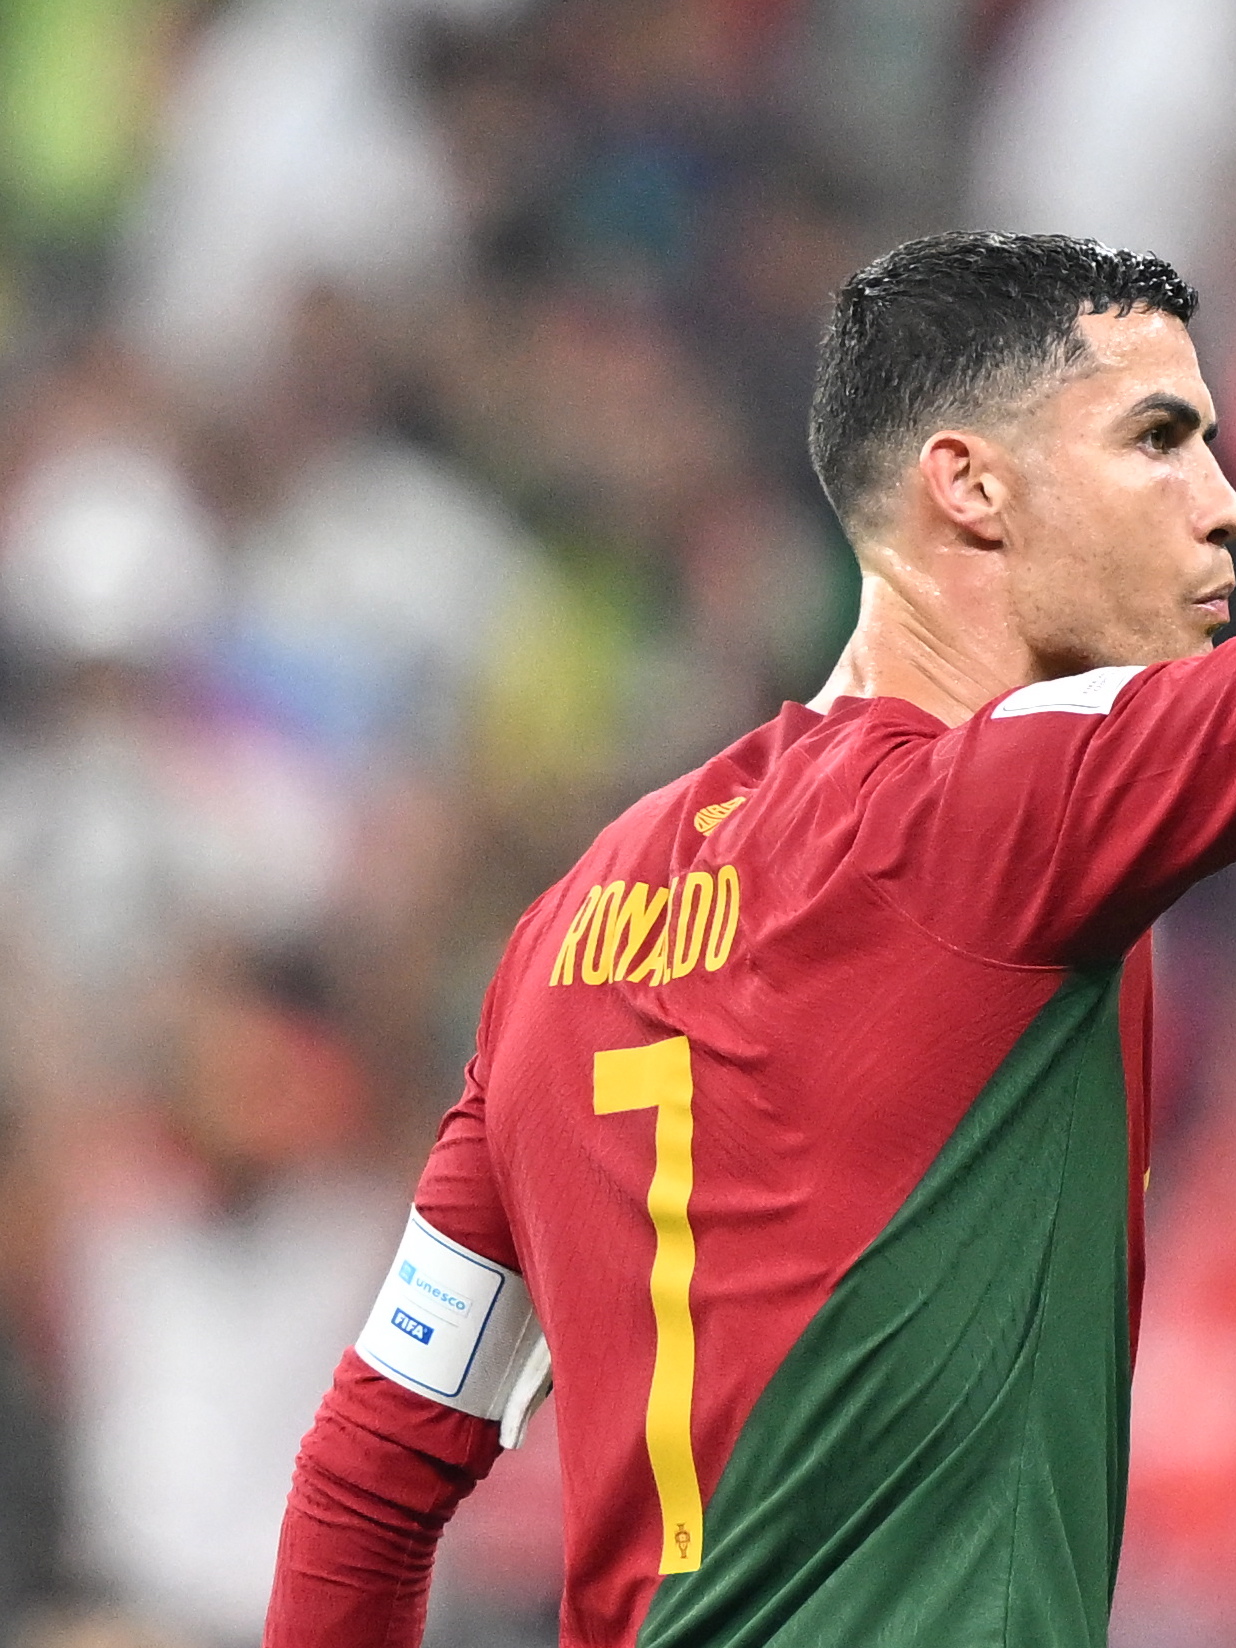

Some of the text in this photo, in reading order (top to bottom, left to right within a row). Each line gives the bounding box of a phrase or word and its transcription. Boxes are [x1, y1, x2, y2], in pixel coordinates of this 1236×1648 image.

[416, 1278, 466, 1310] unesco
[594, 1035, 703, 1574] 7
[394, 1311, 427, 1340] FIFA
